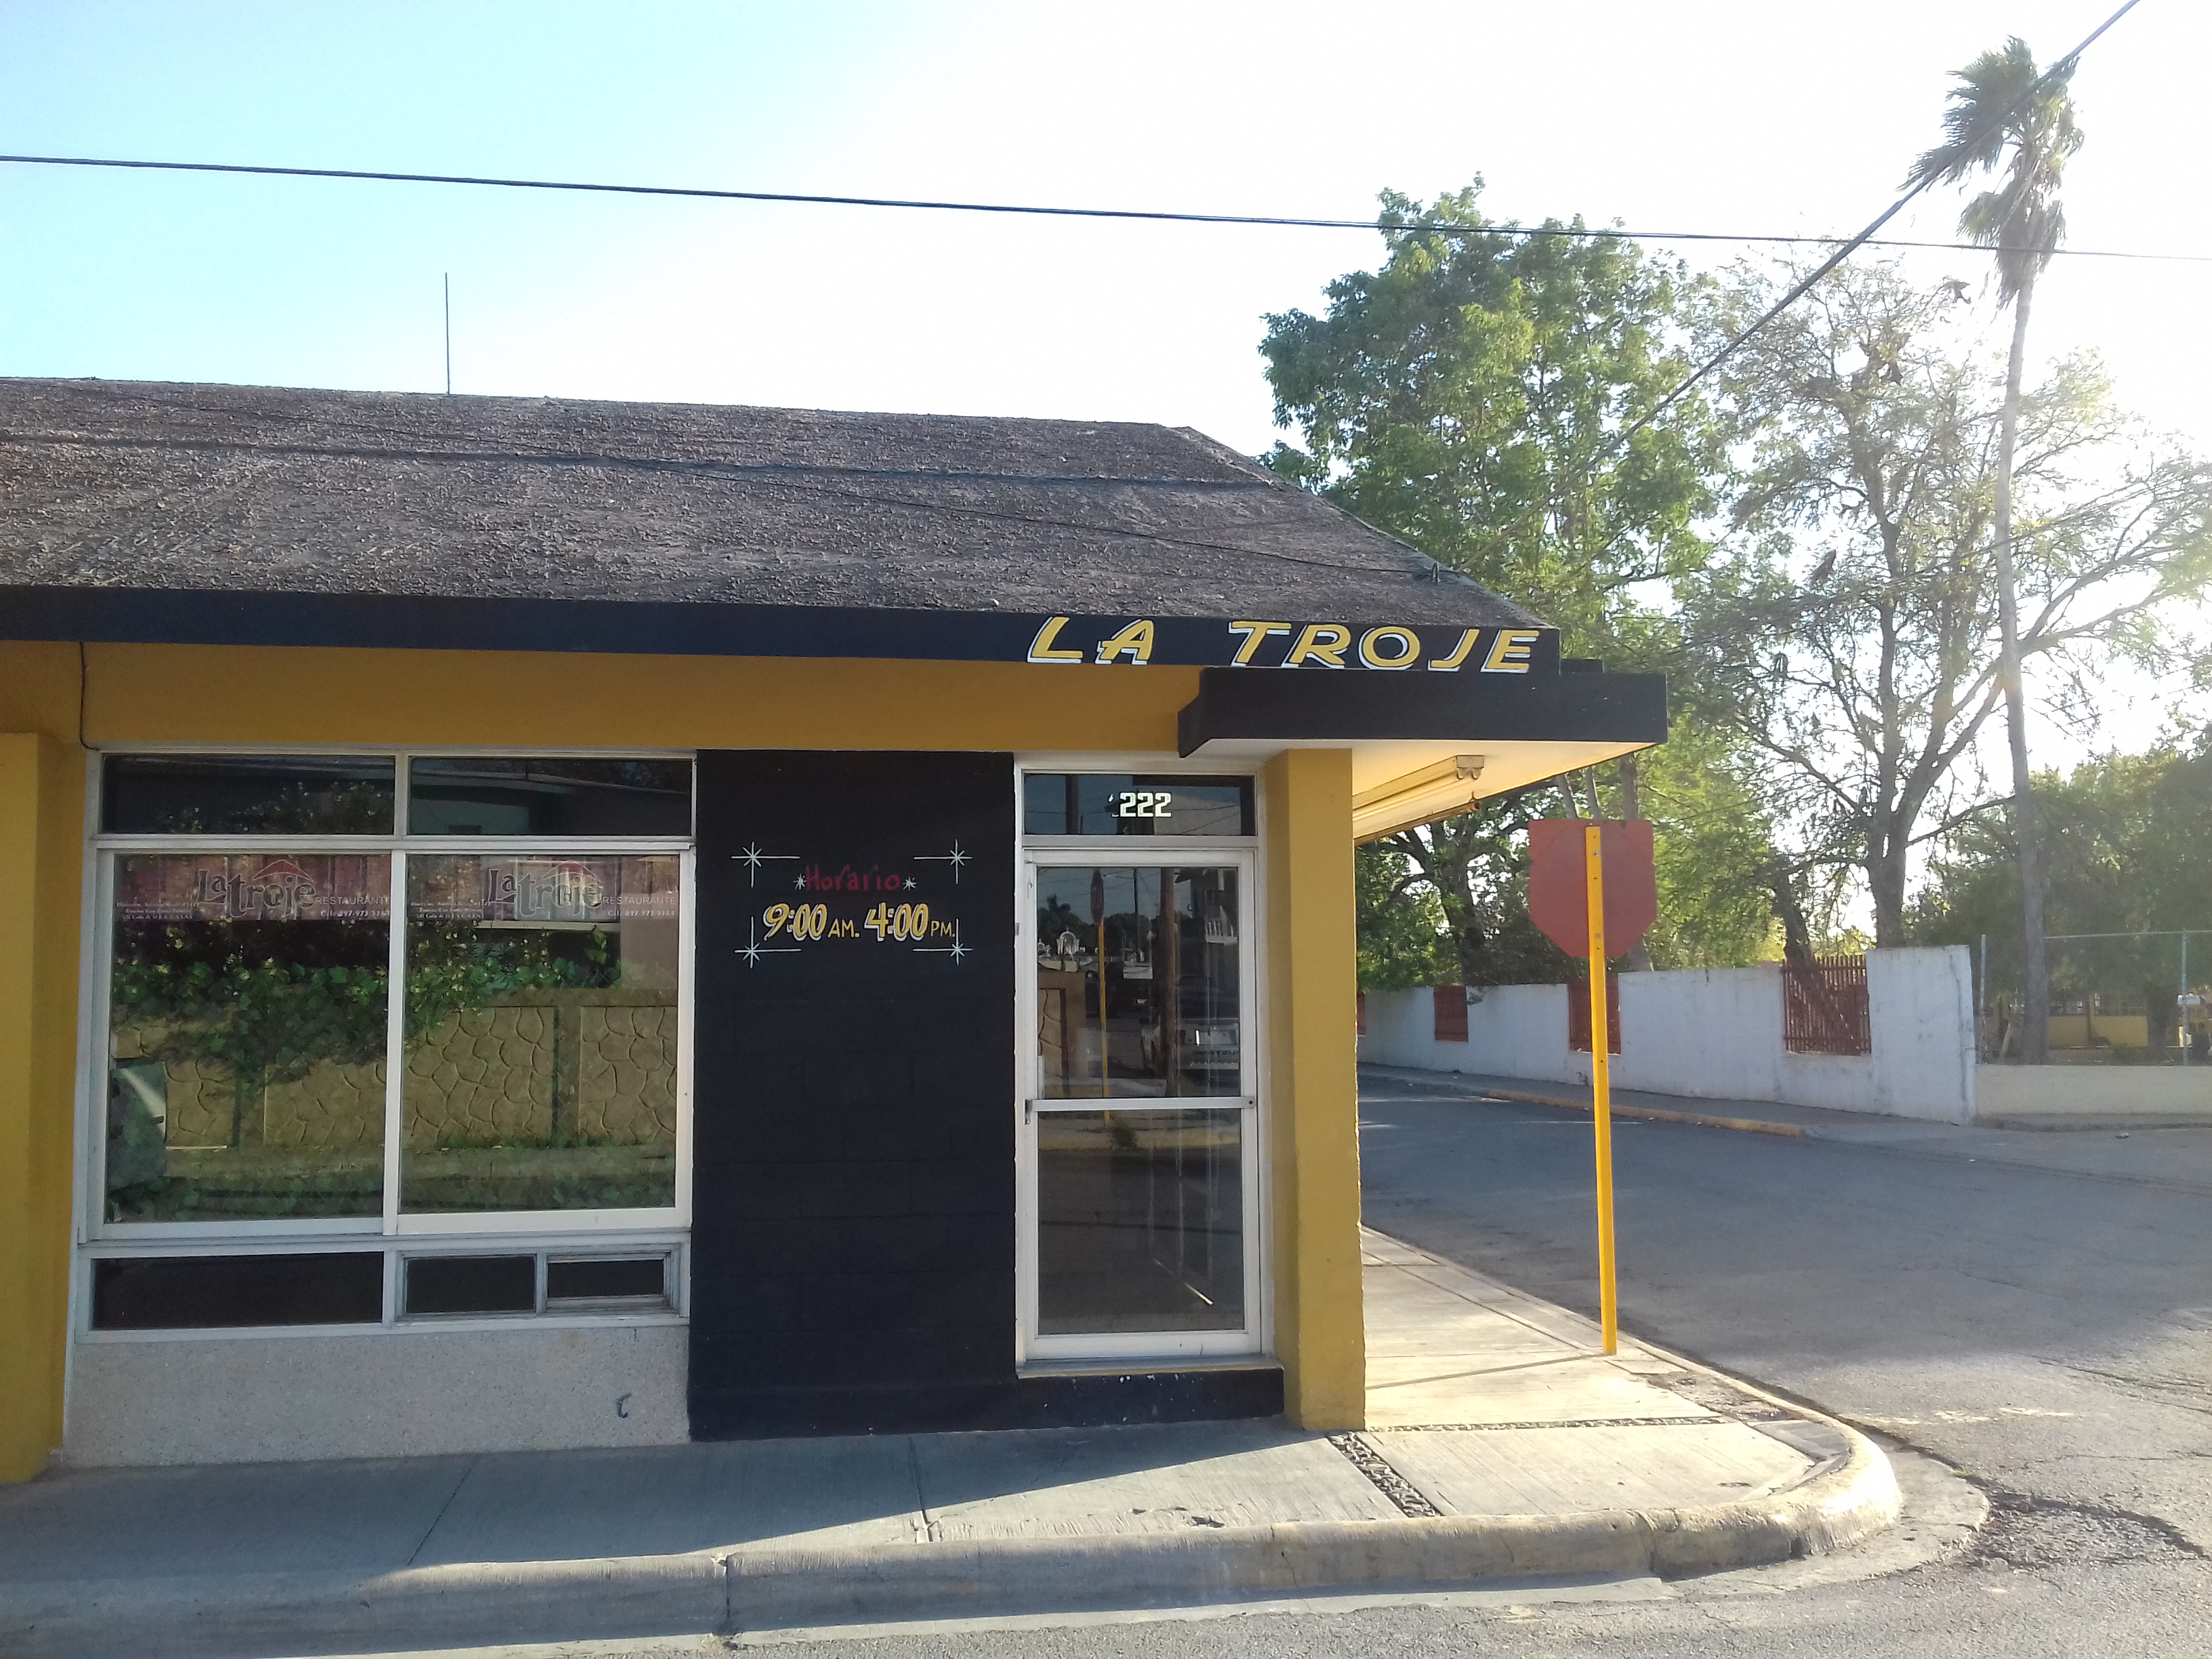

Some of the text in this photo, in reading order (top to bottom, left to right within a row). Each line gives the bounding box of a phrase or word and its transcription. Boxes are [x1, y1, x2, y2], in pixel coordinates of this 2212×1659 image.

[1025, 616, 1540, 674] LA TROJE
[197, 869, 316, 918] La troje
[488, 869, 604, 917] La troje
[805, 864, 901, 891] Horario
[602, 896, 676, 905] RESTAURANTE
[762, 903, 828, 941] 9:00
[864, 902, 929, 943] 4:00
